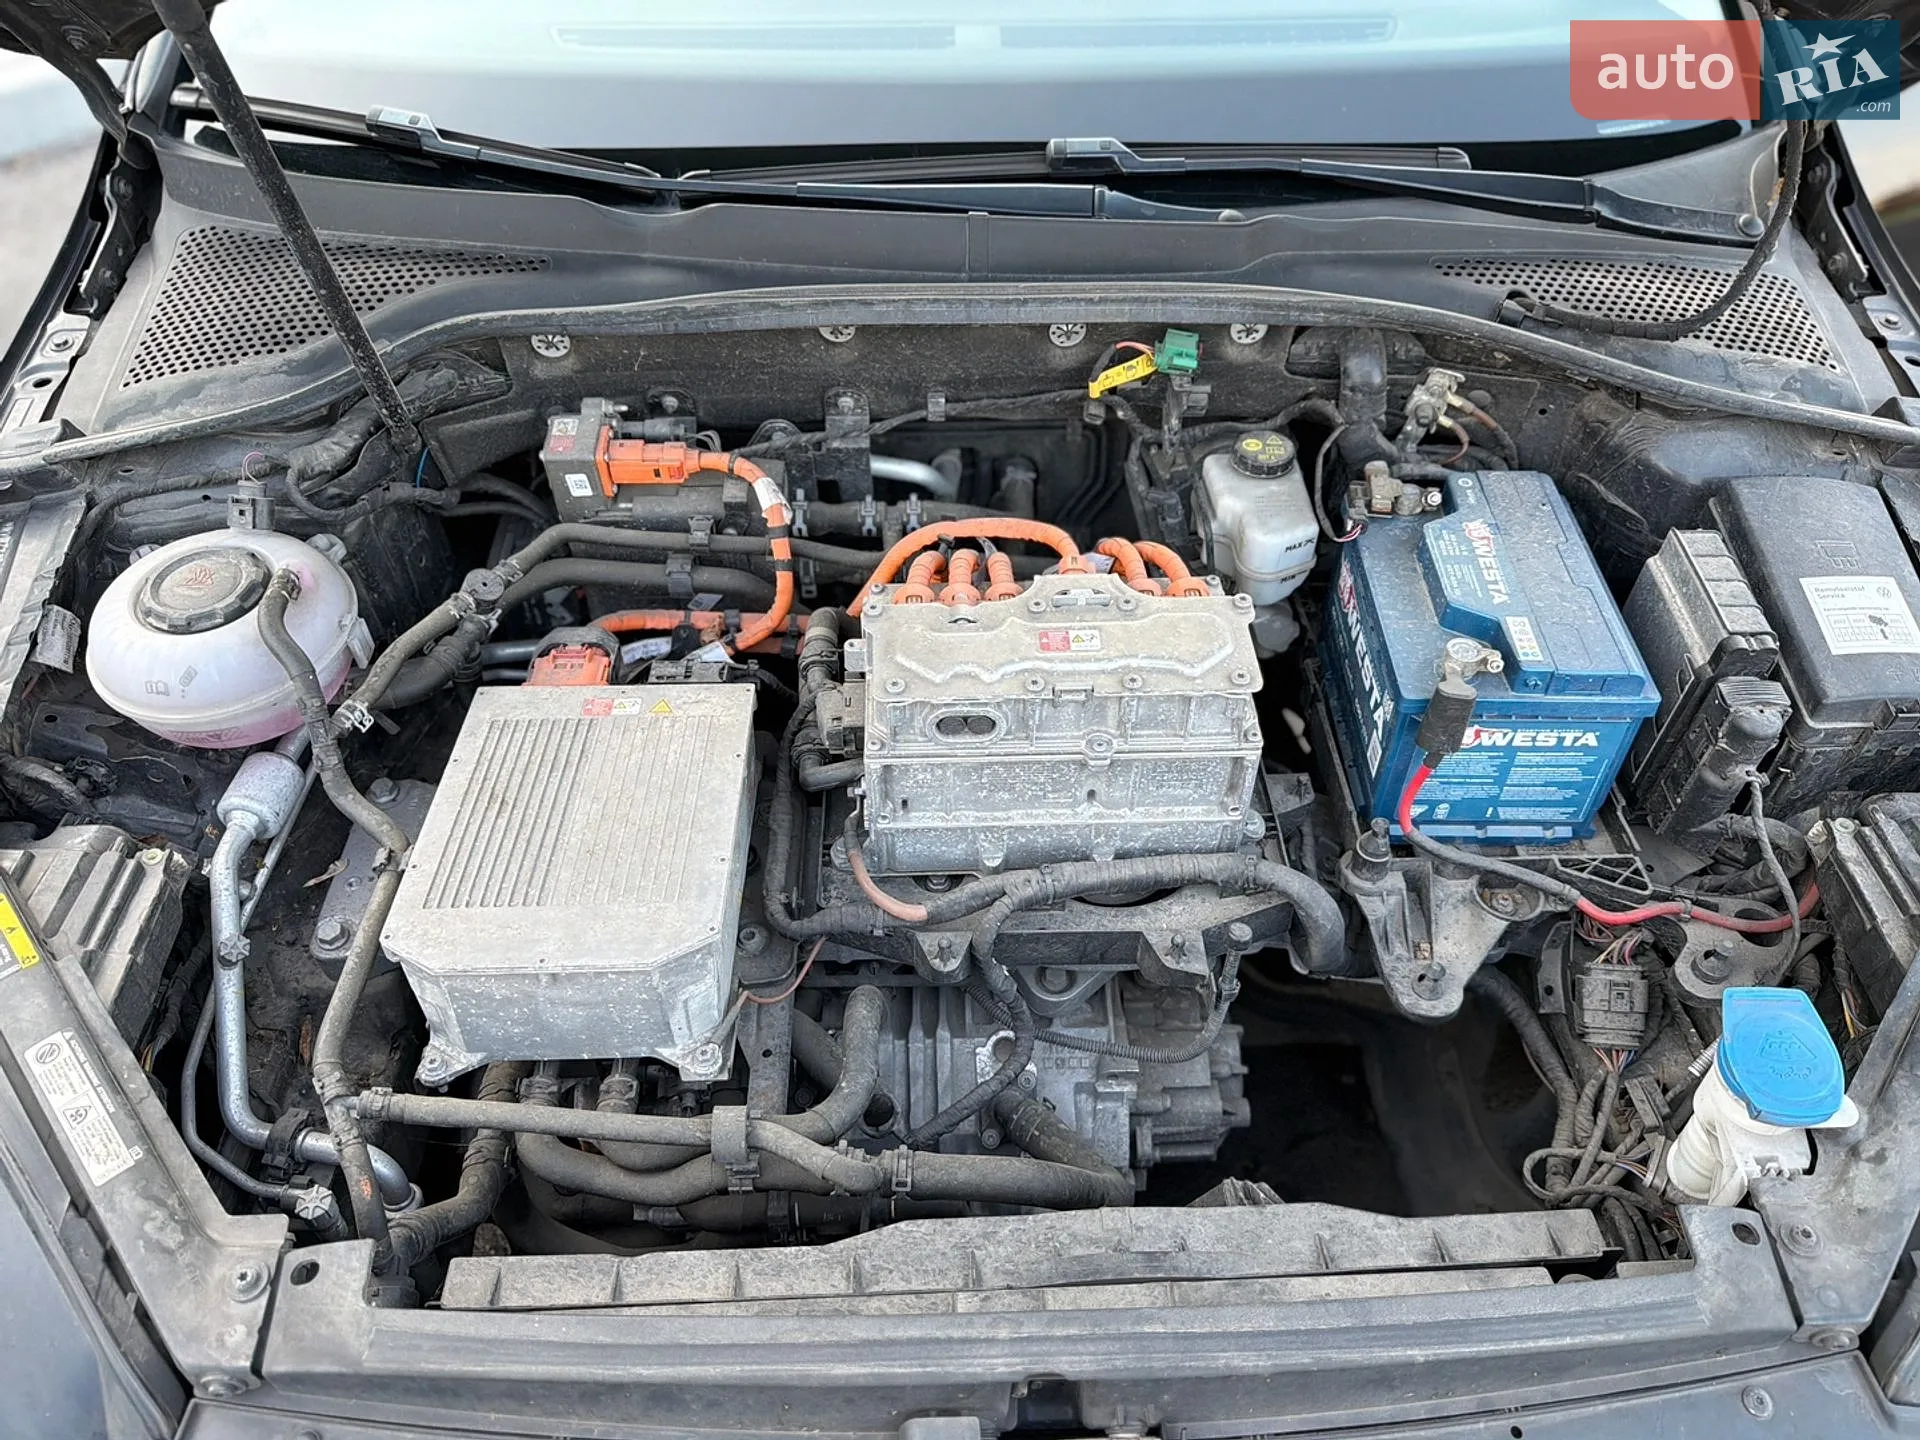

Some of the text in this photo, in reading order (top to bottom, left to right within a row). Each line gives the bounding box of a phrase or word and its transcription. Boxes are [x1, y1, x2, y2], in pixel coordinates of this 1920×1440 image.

[1285, 541, 1302, 552] MAX
[1472, 540, 1511, 604] WESTA
[1347, 608, 1383, 741] WESTA
[1480, 731, 1599, 747] WESTA
